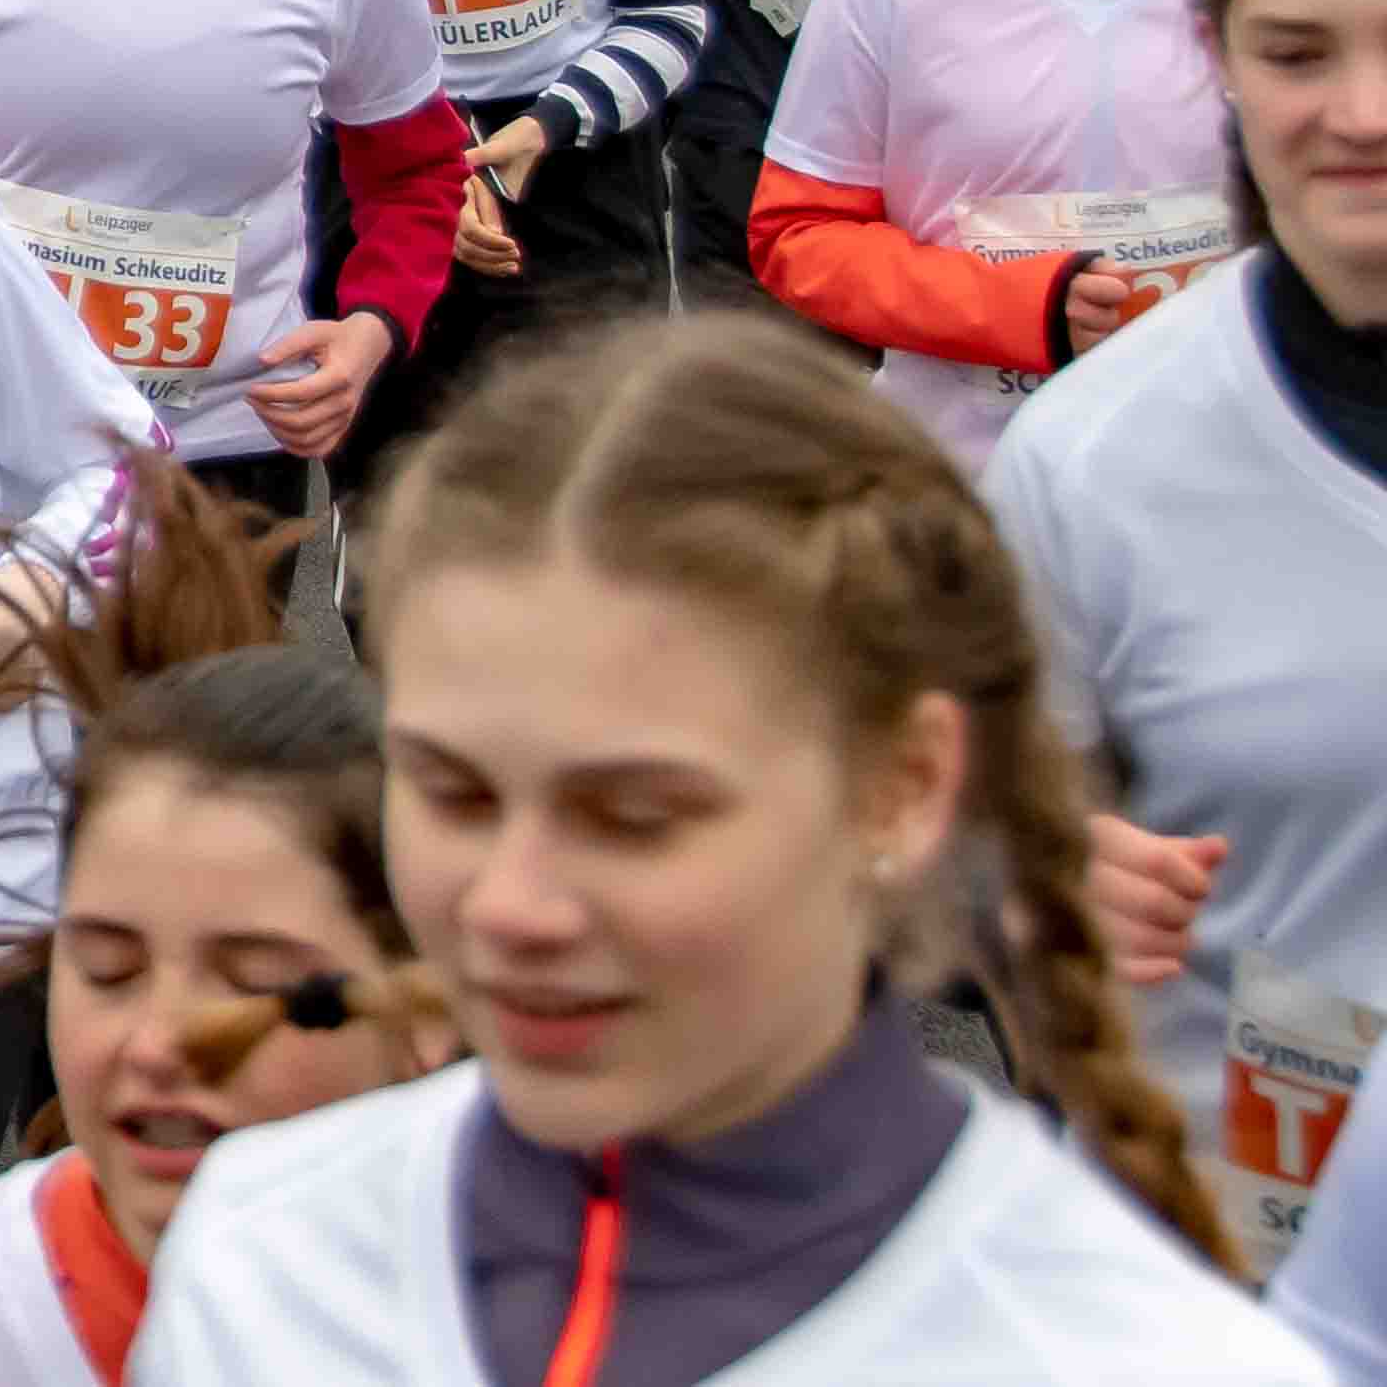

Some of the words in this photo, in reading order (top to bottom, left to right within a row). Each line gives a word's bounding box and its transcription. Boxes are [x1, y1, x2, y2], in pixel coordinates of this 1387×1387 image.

[86, 209, 154, 233] Leipziger
[113, 256, 227, 286] Schkeuditz
[113, 290, 208, 363] 33
[1249, 1070, 1325, 1177] T
